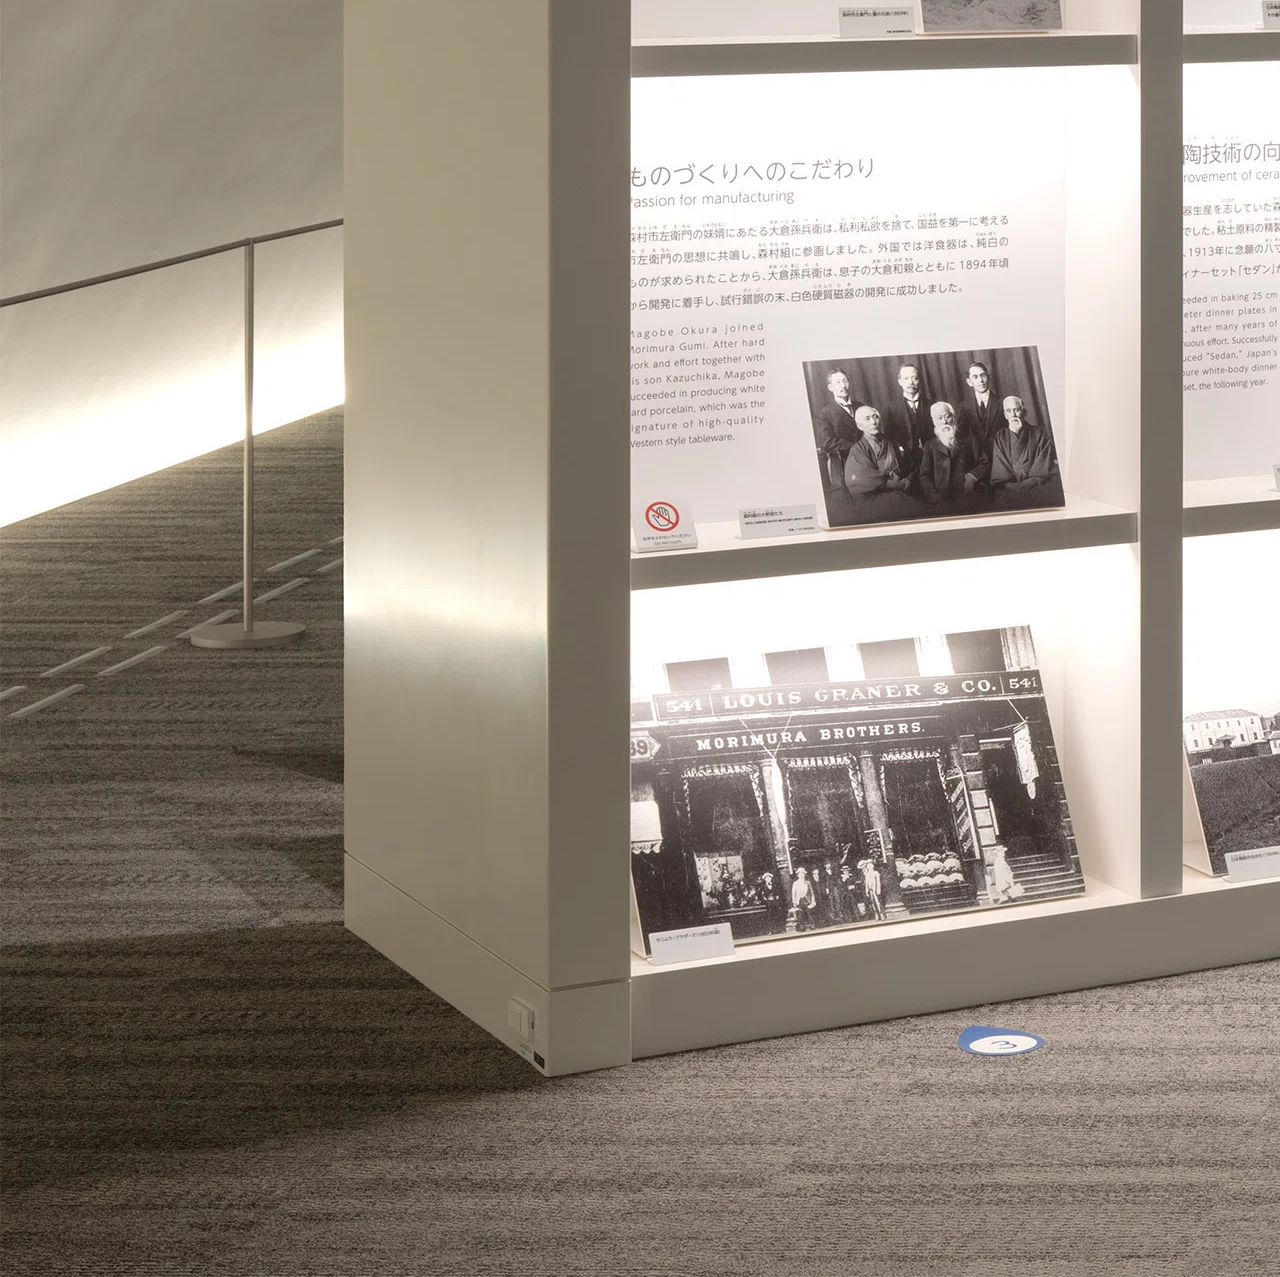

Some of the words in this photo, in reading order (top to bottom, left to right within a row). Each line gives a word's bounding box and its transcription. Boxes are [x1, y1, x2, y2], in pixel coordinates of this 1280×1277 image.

[631, 157, 874, 188] ものづくりへのこだわり
[1183, 170, 1238, 184] rovement
[1240, 168, 1253, 181] of
[679, 193, 698, 206] for
[701, 190, 795, 205] manufacturing
[712, 339, 739, 349] After
[741, 337, 765, 348] hard
[631, 359, 650, 373] ork
[652, 358, 671, 369] and
[673, 356, 700, 368] effort
[701, 354, 743, 368] together
[744, 352, 766, 365] with
[664, 697, 704, 714] 541
[723, 691, 803, 710] LOUIS
[814, 682, 923, 702] GRANER
[932, 682, 950, 694] &
[960, 678, 997, 694] CO.
[1008, 677, 1037, 690] 541
[696, 730, 808, 752] MORIMURA
[820, 721, 926, 740] BROTHERS.
[991, 1039, 1018, 1050] 3
